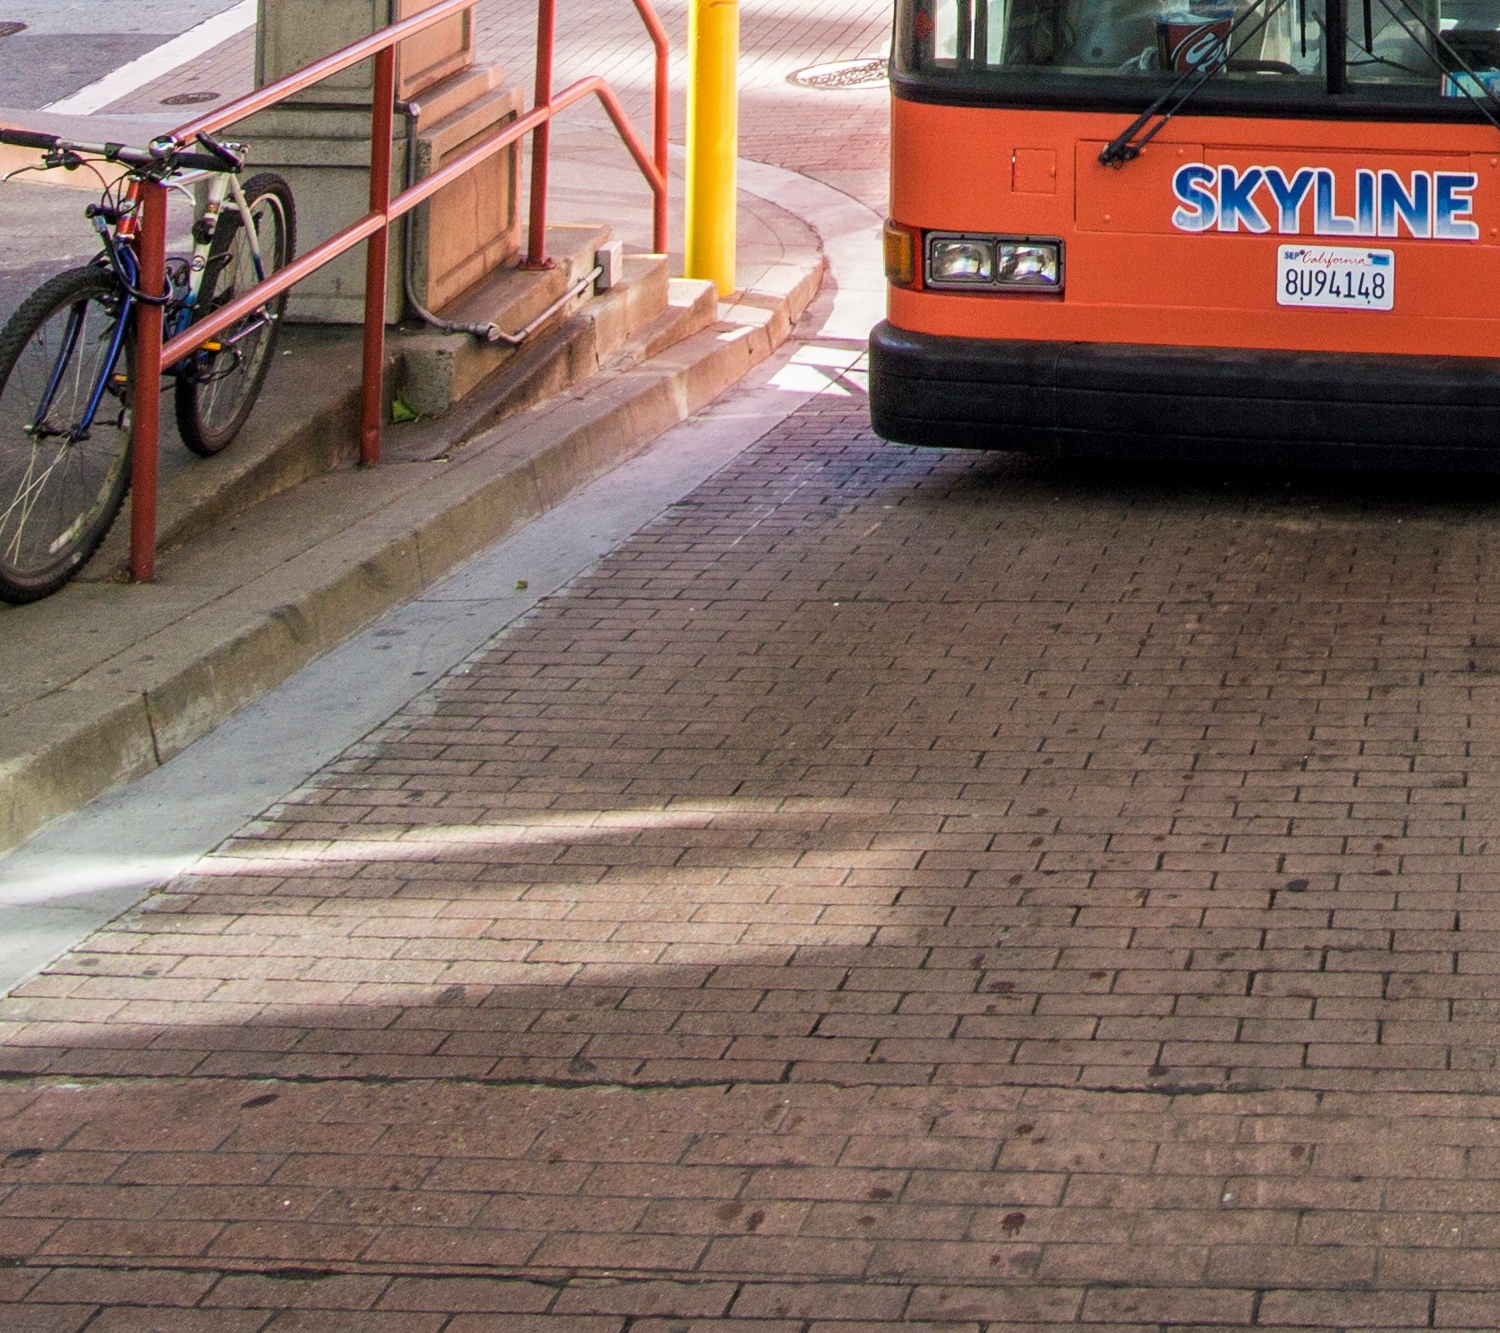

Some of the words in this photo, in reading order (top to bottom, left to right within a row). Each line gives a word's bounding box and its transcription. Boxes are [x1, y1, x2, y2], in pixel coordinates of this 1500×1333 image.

[1171, 162, 1480, 240] SKYLINE
[1302, 250, 1372, 268] California
[1285, 268, 1385, 300] 8U94148
